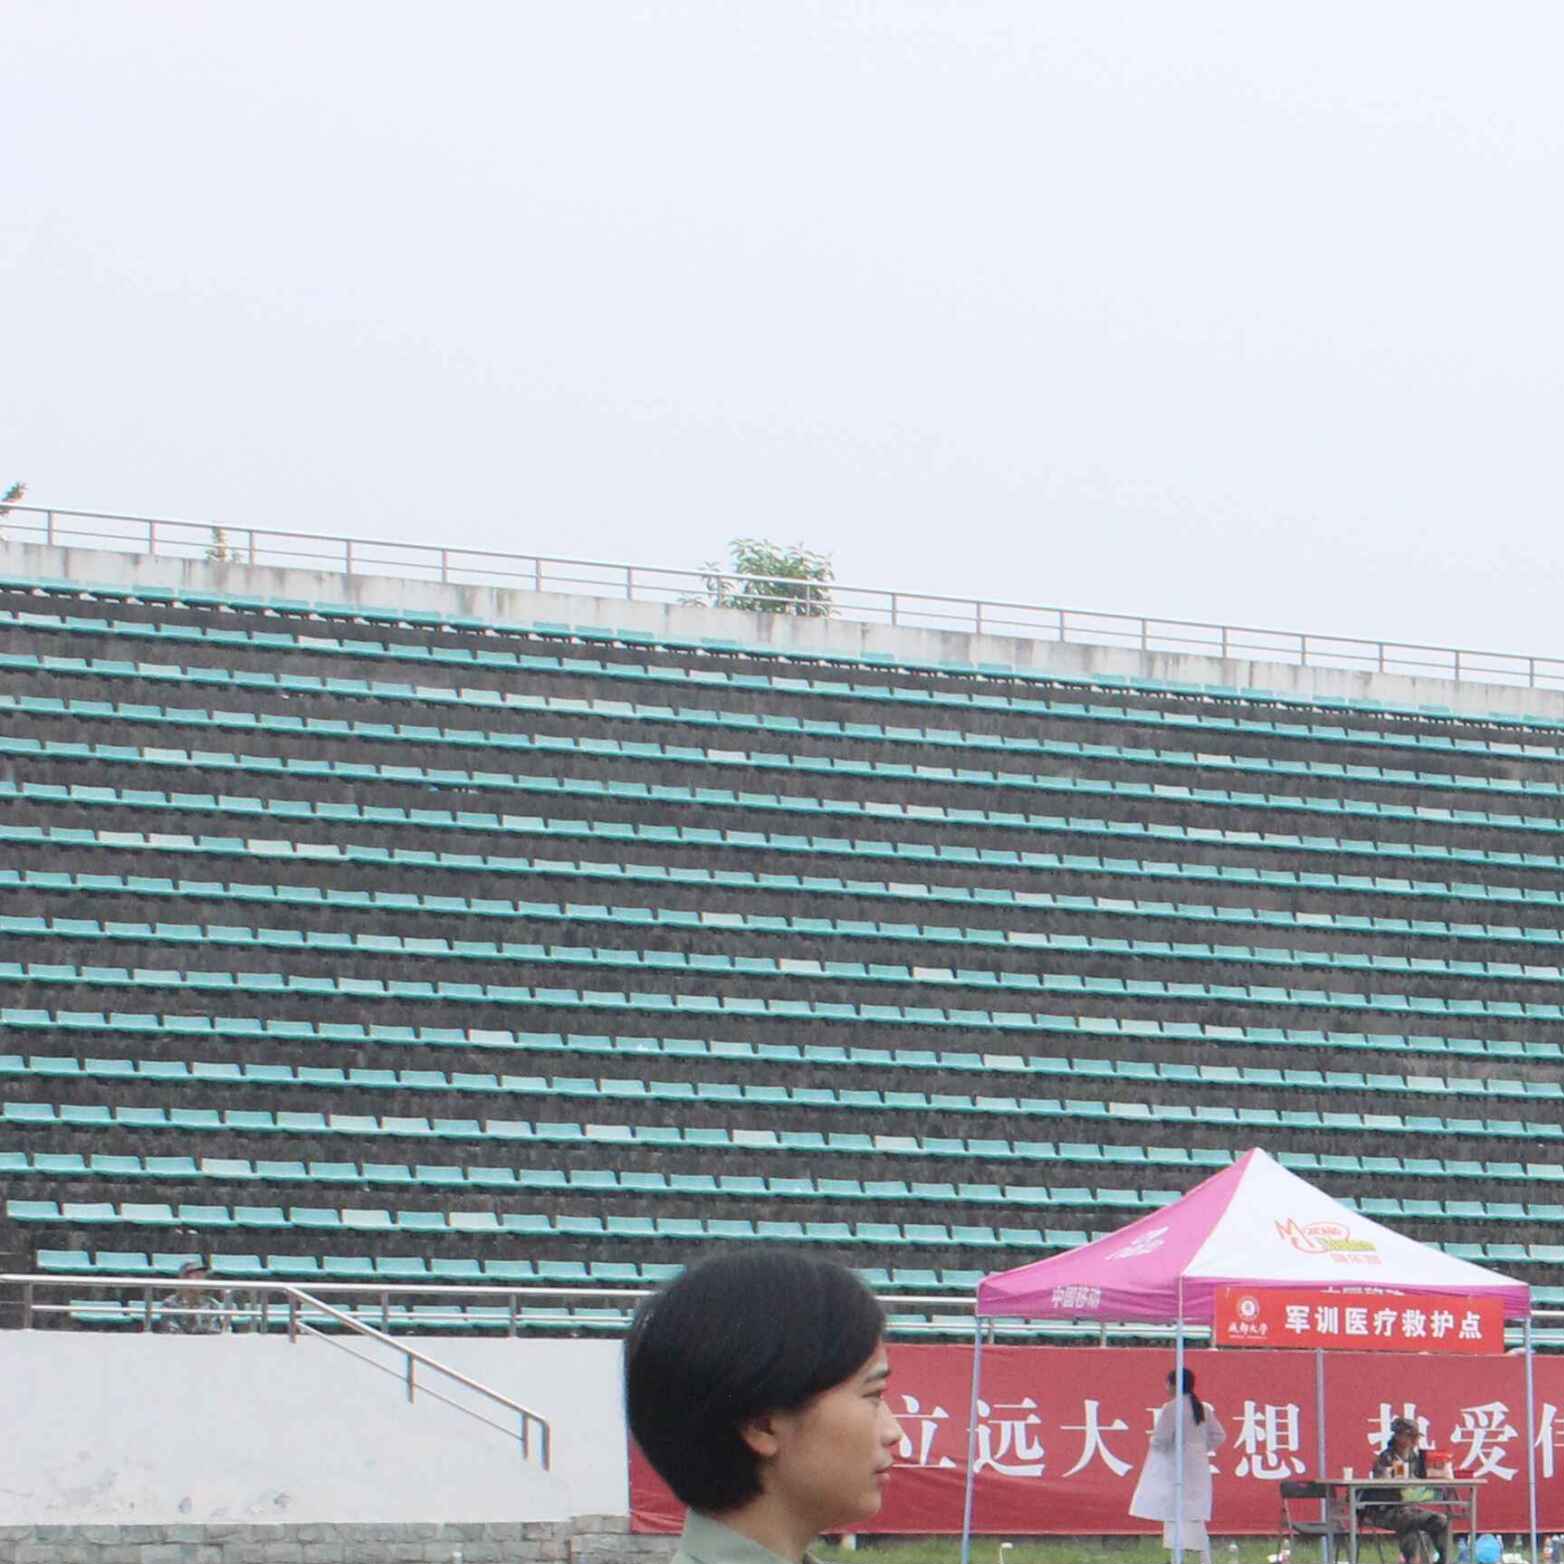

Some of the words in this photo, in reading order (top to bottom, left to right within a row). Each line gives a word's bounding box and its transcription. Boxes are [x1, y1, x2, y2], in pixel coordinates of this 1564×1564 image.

[1285, 1305, 1483, 1339] 军训医疗救护点
[892, 1395, 1306, 1480] 立远大想
